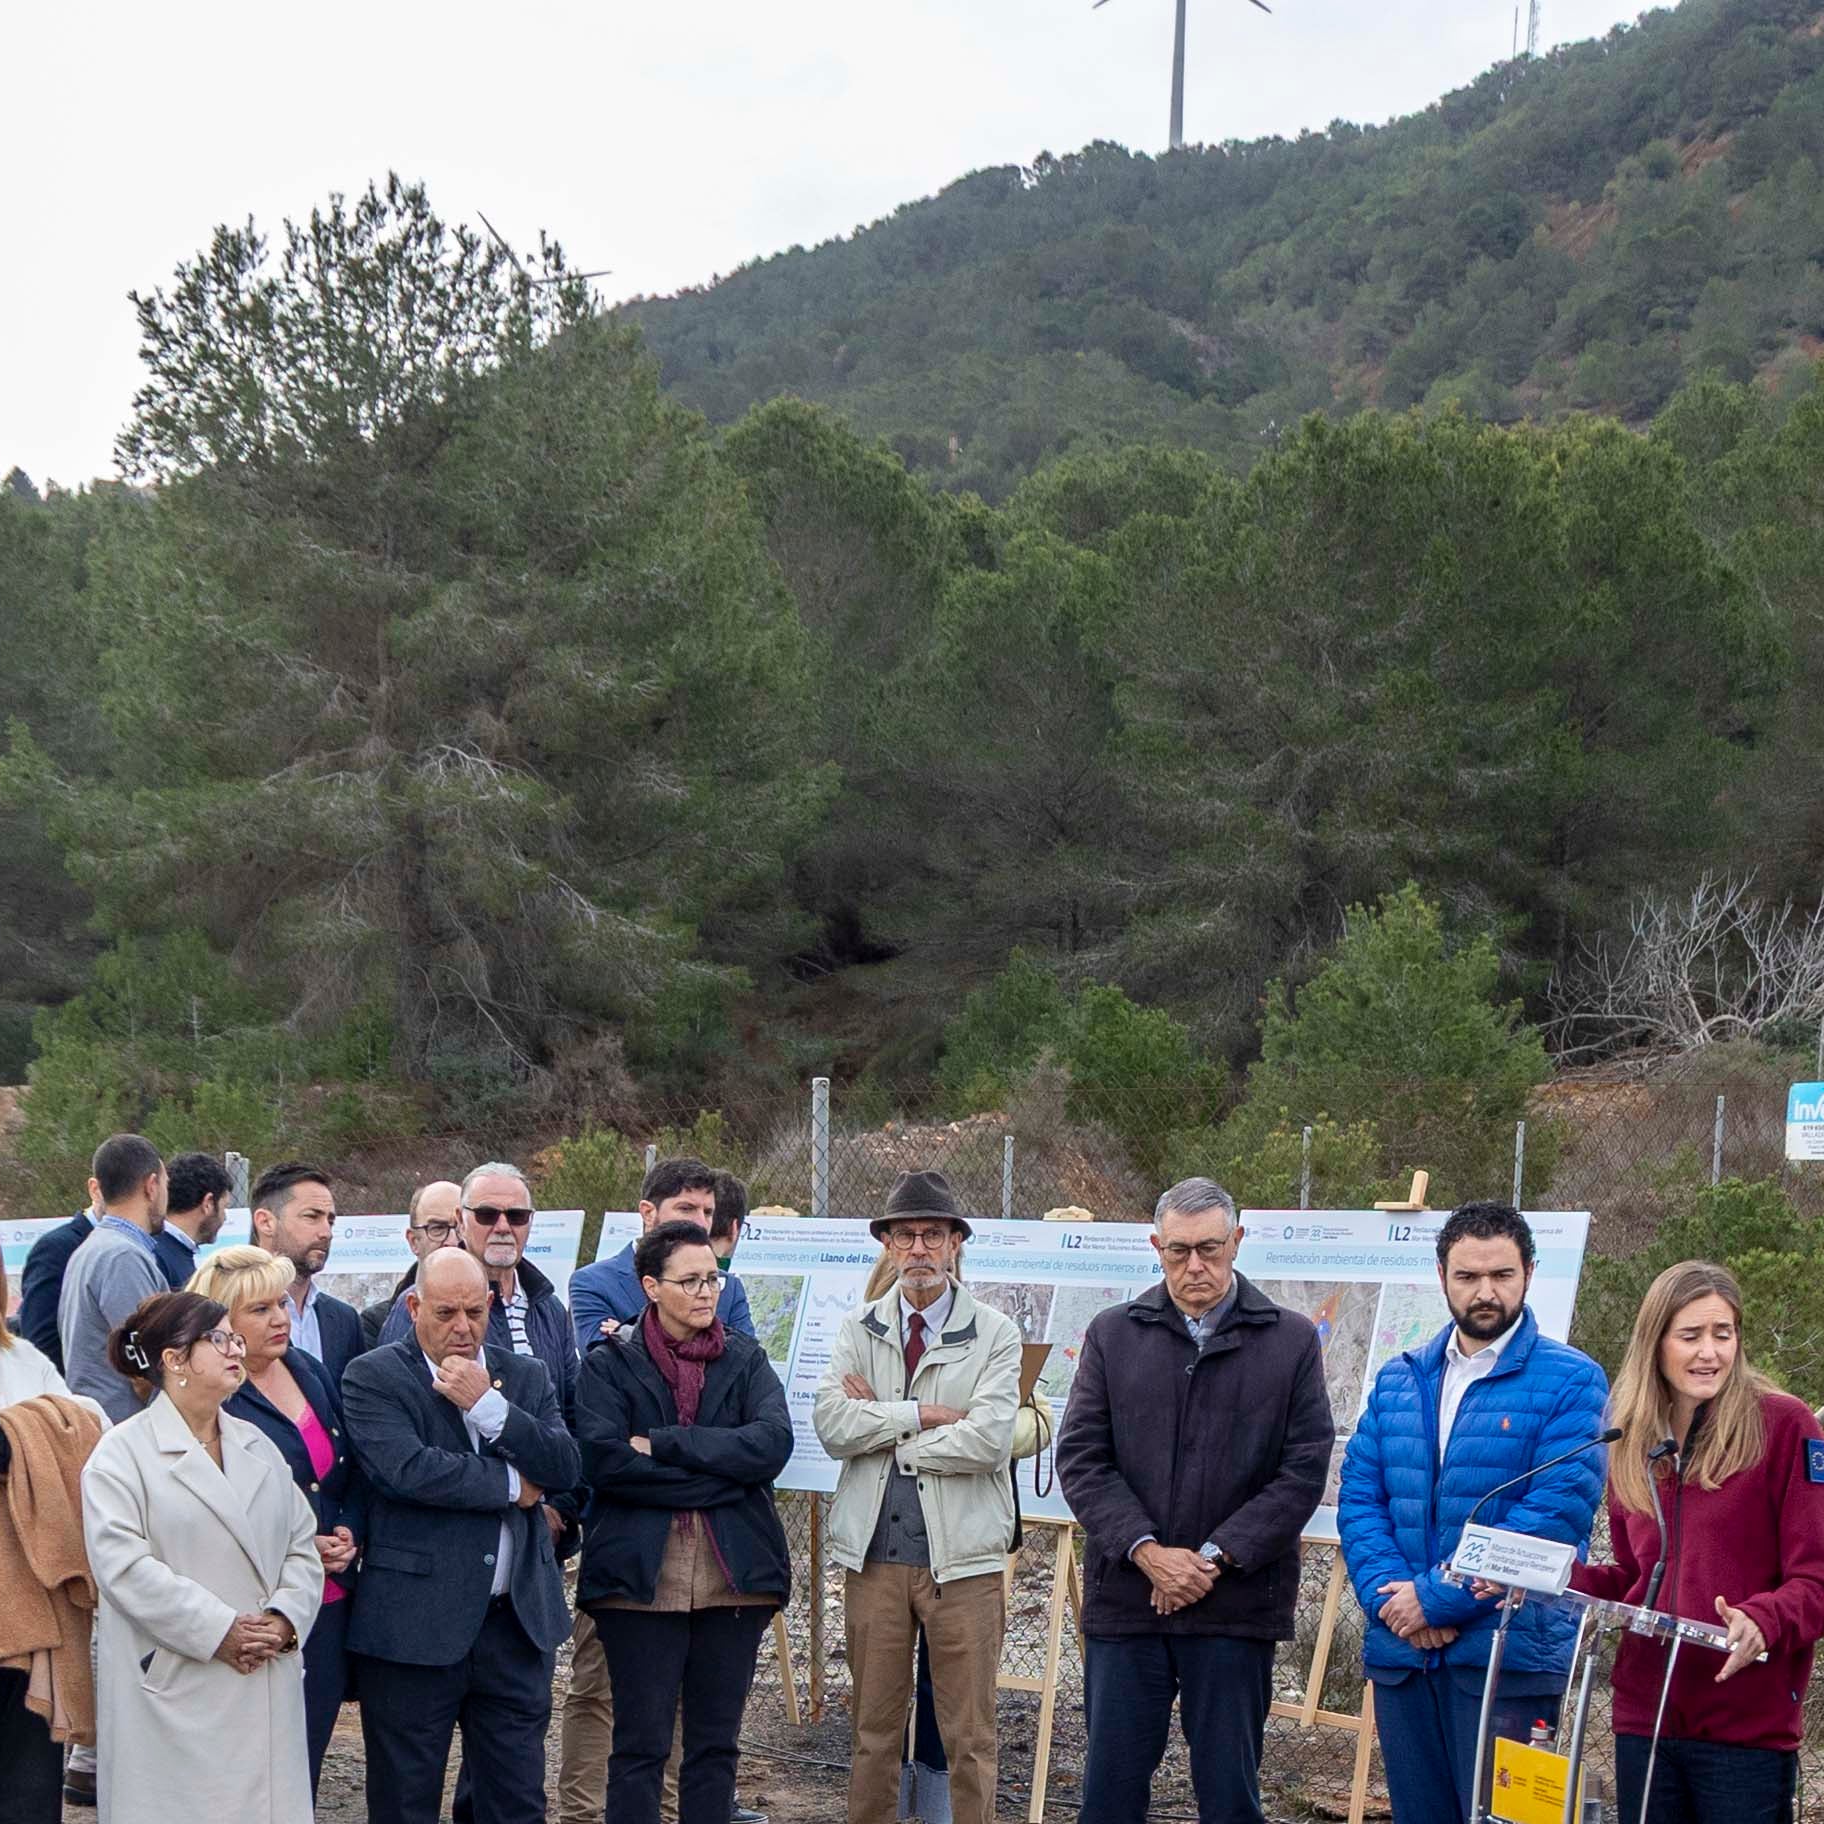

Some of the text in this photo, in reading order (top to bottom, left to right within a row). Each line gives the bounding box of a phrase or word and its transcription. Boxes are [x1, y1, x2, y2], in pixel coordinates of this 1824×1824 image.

[747, 1228, 762, 1241] L2
[1394, 1226, 1411, 1241] L2
[1067, 1234, 1082, 1249] L2
[820, 1253, 845, 1263] Llano
[846, 1253, 860, 1263] del
[1265, 1250, 1321, 1265] Remediación
[1322, 1251, 1366, 1265] ambiental
